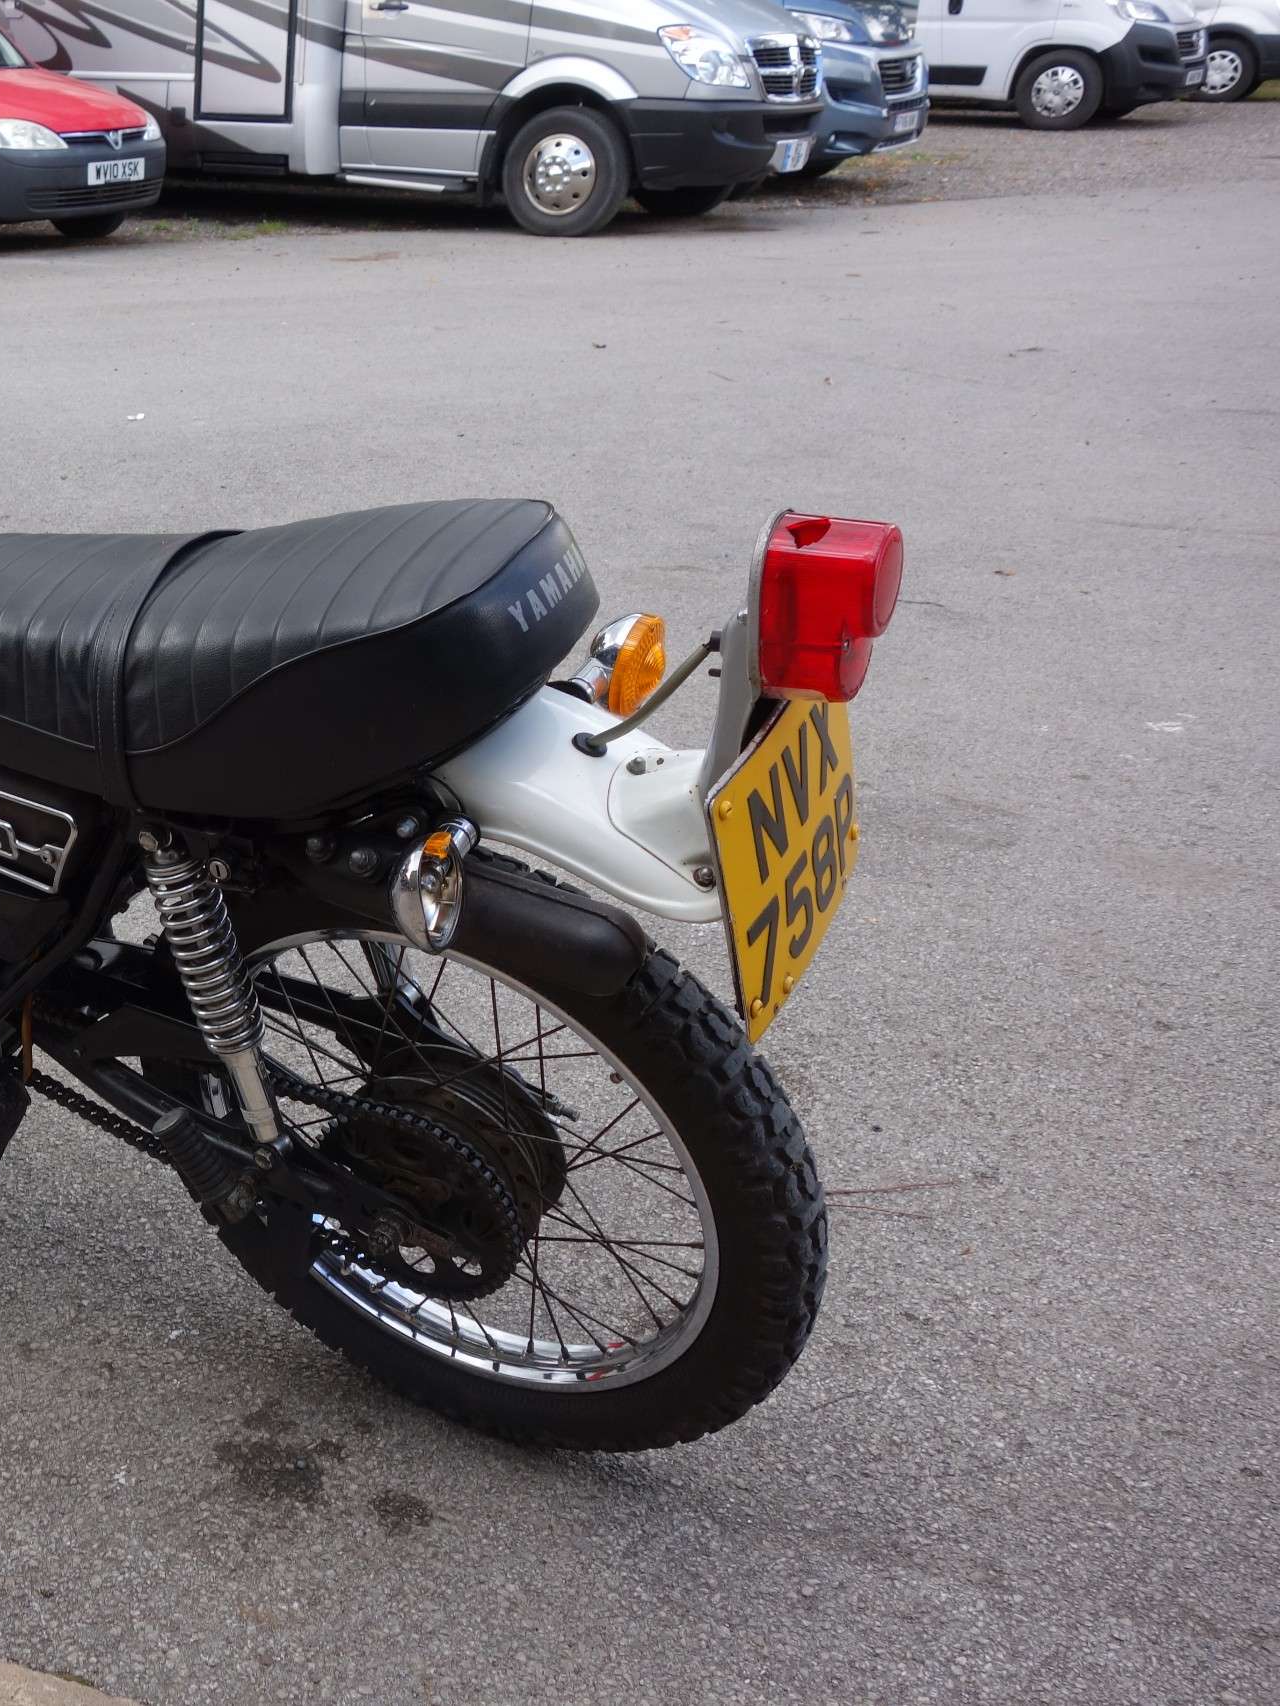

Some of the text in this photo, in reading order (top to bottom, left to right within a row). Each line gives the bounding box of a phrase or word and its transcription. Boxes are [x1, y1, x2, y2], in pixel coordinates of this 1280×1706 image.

[95, 161, 140, 180] WV10 XSK
[747, 702, 839, 885] NVX
[746, 773, 853, 1008] 758P
